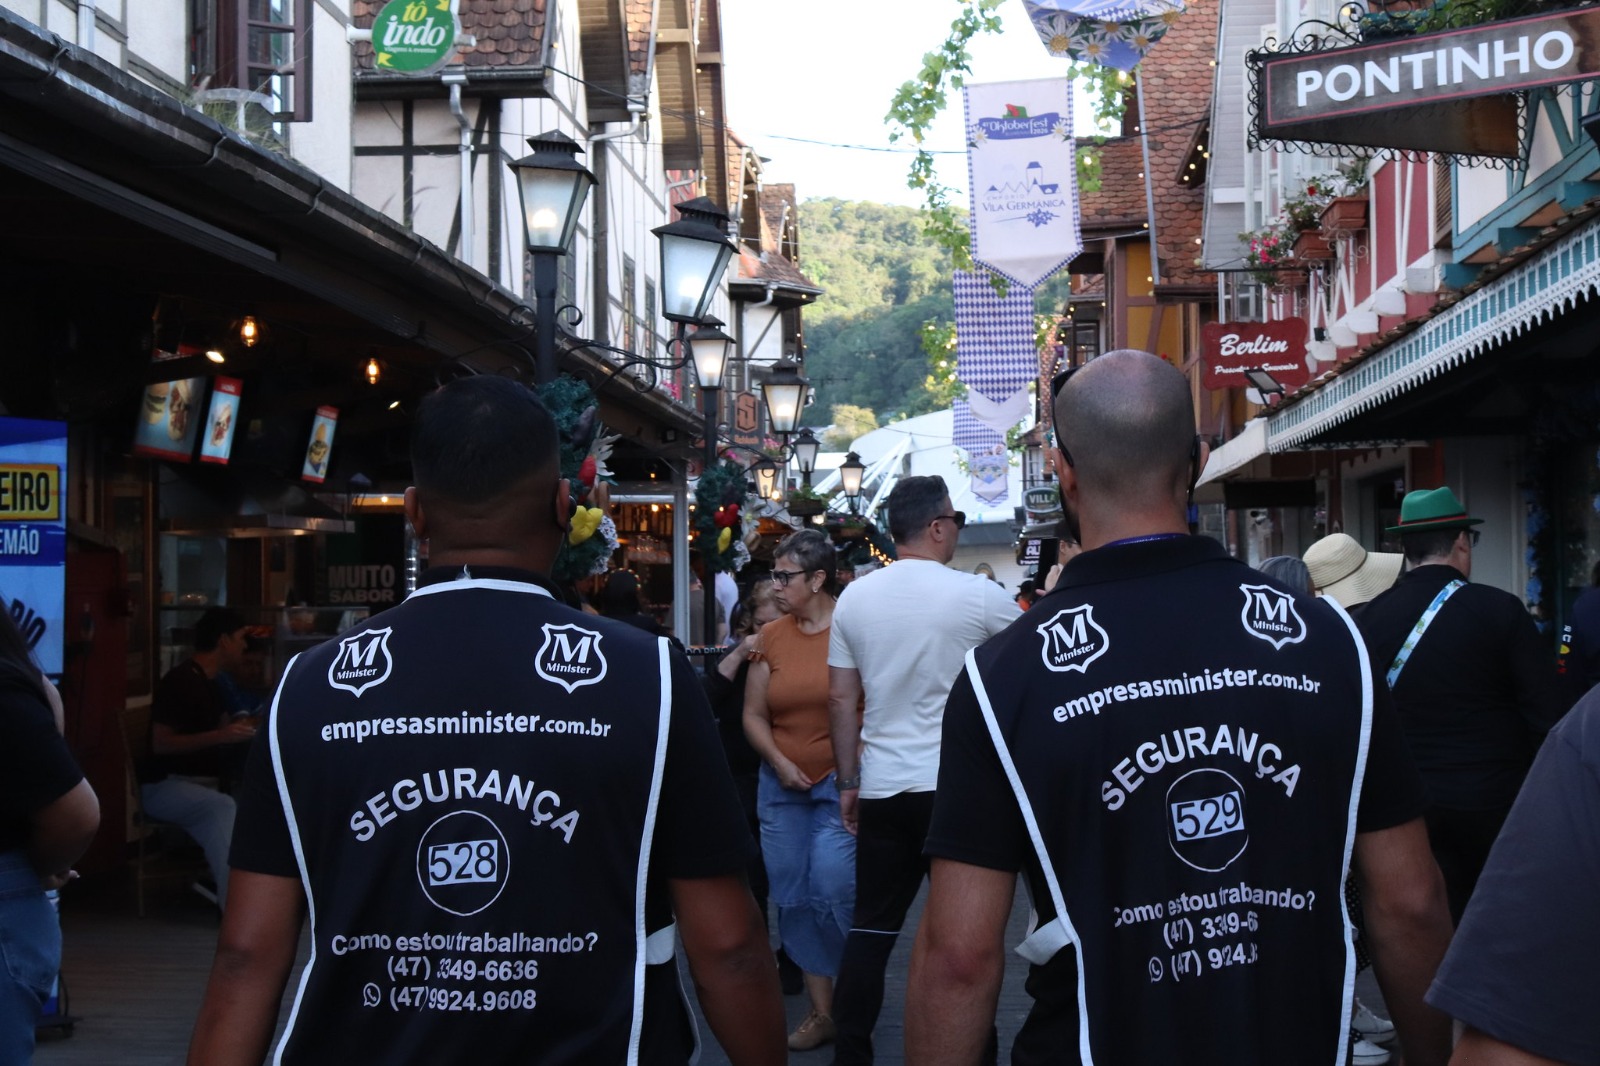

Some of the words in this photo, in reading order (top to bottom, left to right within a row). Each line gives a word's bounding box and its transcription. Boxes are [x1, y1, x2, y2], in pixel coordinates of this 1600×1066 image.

[402, 1, 428, 22] tô
[383, 15, 446, 46] indo
[1297, 30, 1574, 107] PONTINHO
[990, 118, 1048, 135] Oktoberfest
[1220, 333, 1288, 356] Berlim
[0, 471, 50, 512] EIRO
[328, 565, 396, 589] MUITO
[329, 589, 395, 603] SABOR
[1252, 592, 1288, 624] M
[1048, 613, 1089, 655] M
[1252, 620, 1293, 634] Minister
[341, 636, 382, 670] M
[551, 633, 592, 664] M
[1054, 642, 1095, 665] Minister
[336, 668, 378, 680] Minister
[545, 662, 592, 675] Minister
[1052, 667, 1321, 723] empresasminister.com.br
[320, 710, 612, 743] empresasminister.com.br
[1101, 724, 1302, 811] SEGURANÇA
[349, 767, 581, 844] SEGURANÇA
[1176, 793, 1241, 839] 529
[429, 840, 497, 882] 528
[1168, 892, 1218, 917] estou
[331, 933, 392, 956] Como
[395, 931, 455, 952] estou
[455, 931, 599, 954] trabalhando?
[1163, 917, 1195, 951] (47)
[387, 955, 431, 982] (47)
[1171, 949, 1203, 982] (47)
